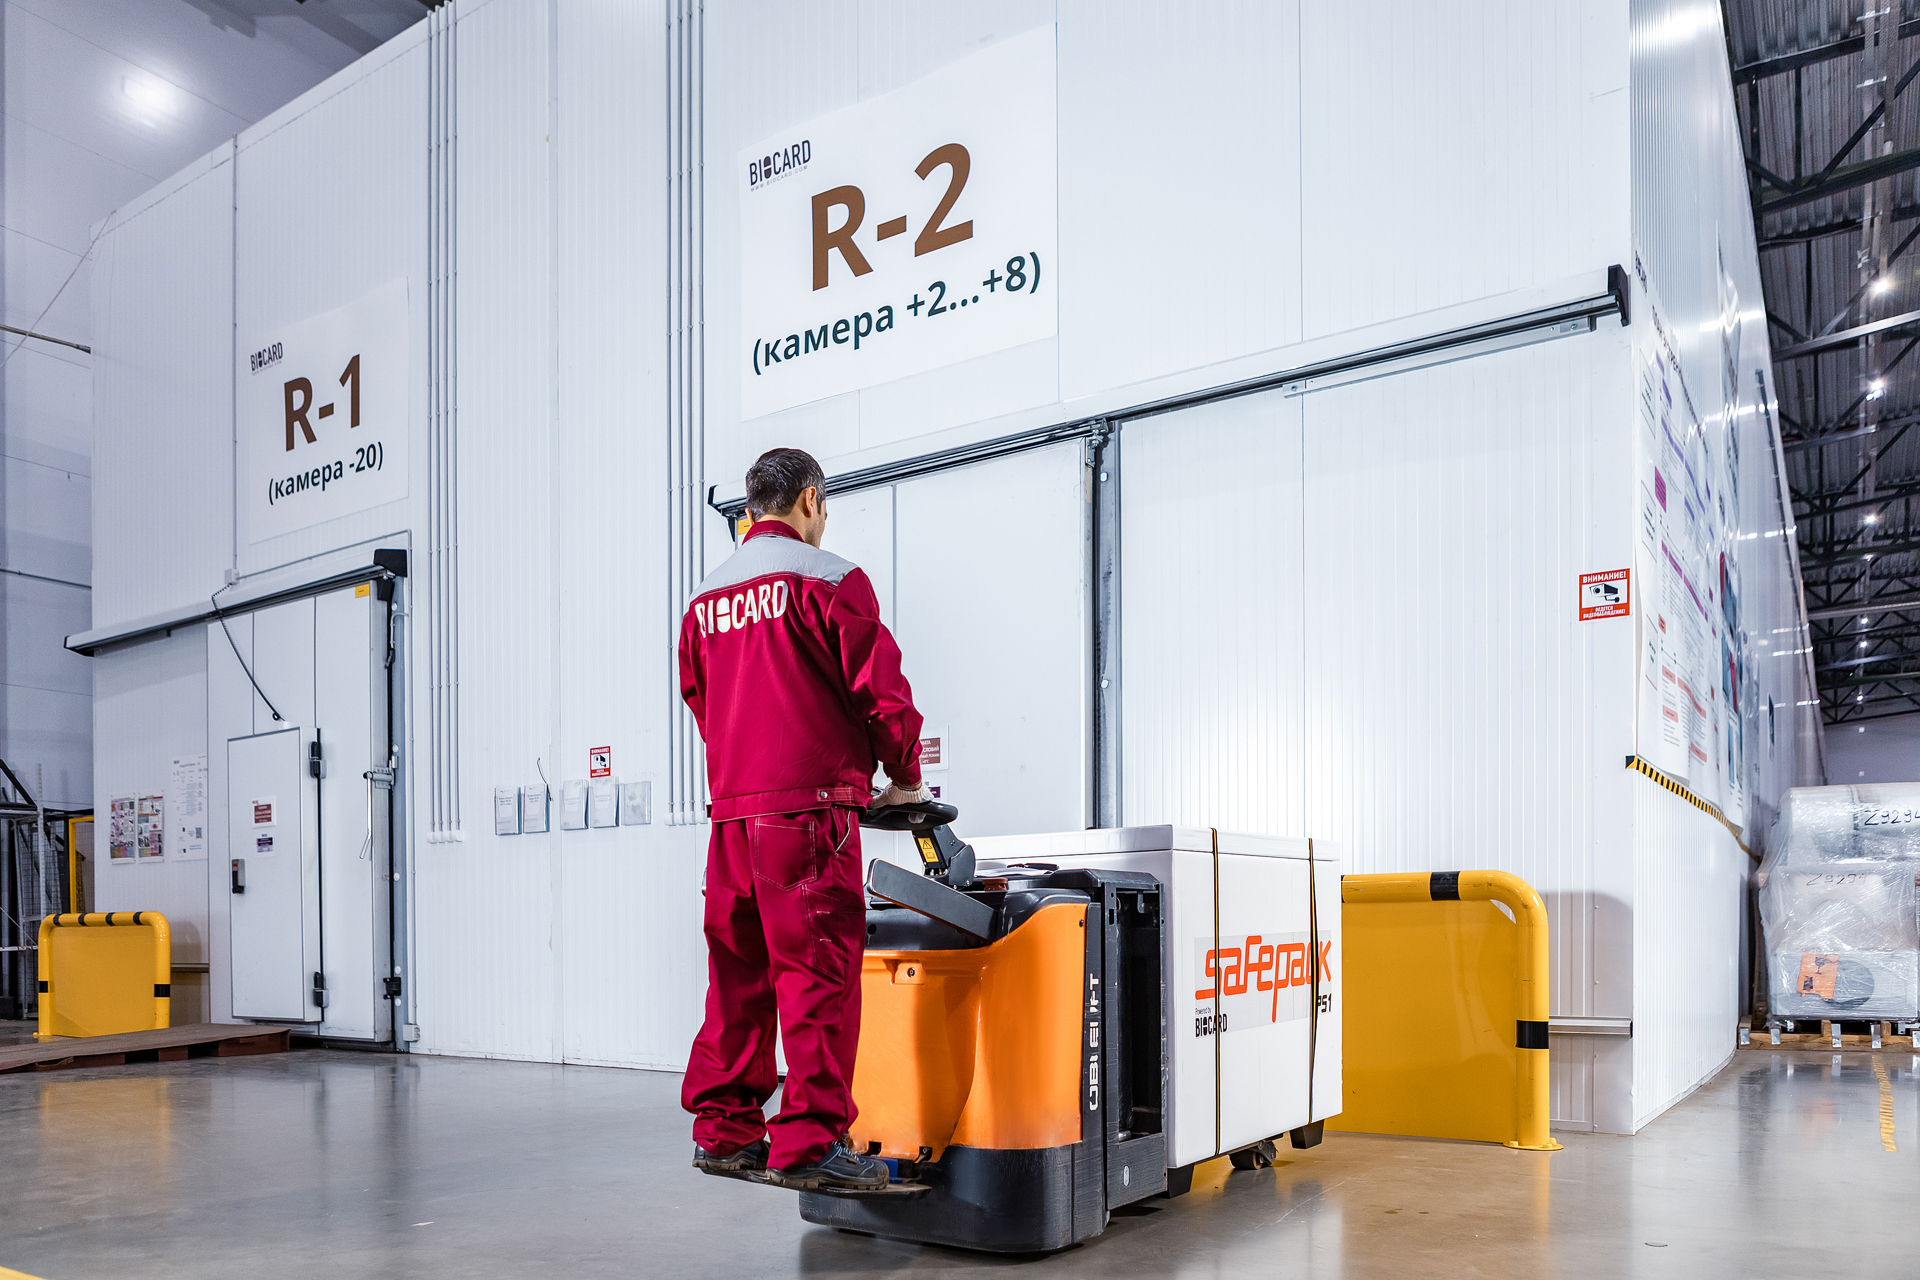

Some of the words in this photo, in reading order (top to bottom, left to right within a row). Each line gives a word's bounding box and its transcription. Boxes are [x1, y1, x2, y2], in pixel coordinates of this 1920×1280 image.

[749, 139, 812, 187] BIOCARD
[811, 142, 974, 292] R-2
[752, 304, 894, 376] (камера
[906, 251, 1041, 317] +2...+8)
[250, 341, 284, 372] BIOCARD
[284, 353, 361, 452] R-1
[268, 459, 343, 506] (камера
[349, 441, 384, 473] -20)
[1582, 571, 1627, 584] ВНИМАНИЕ!
[694, 580, 789, 639] BIOCARD
